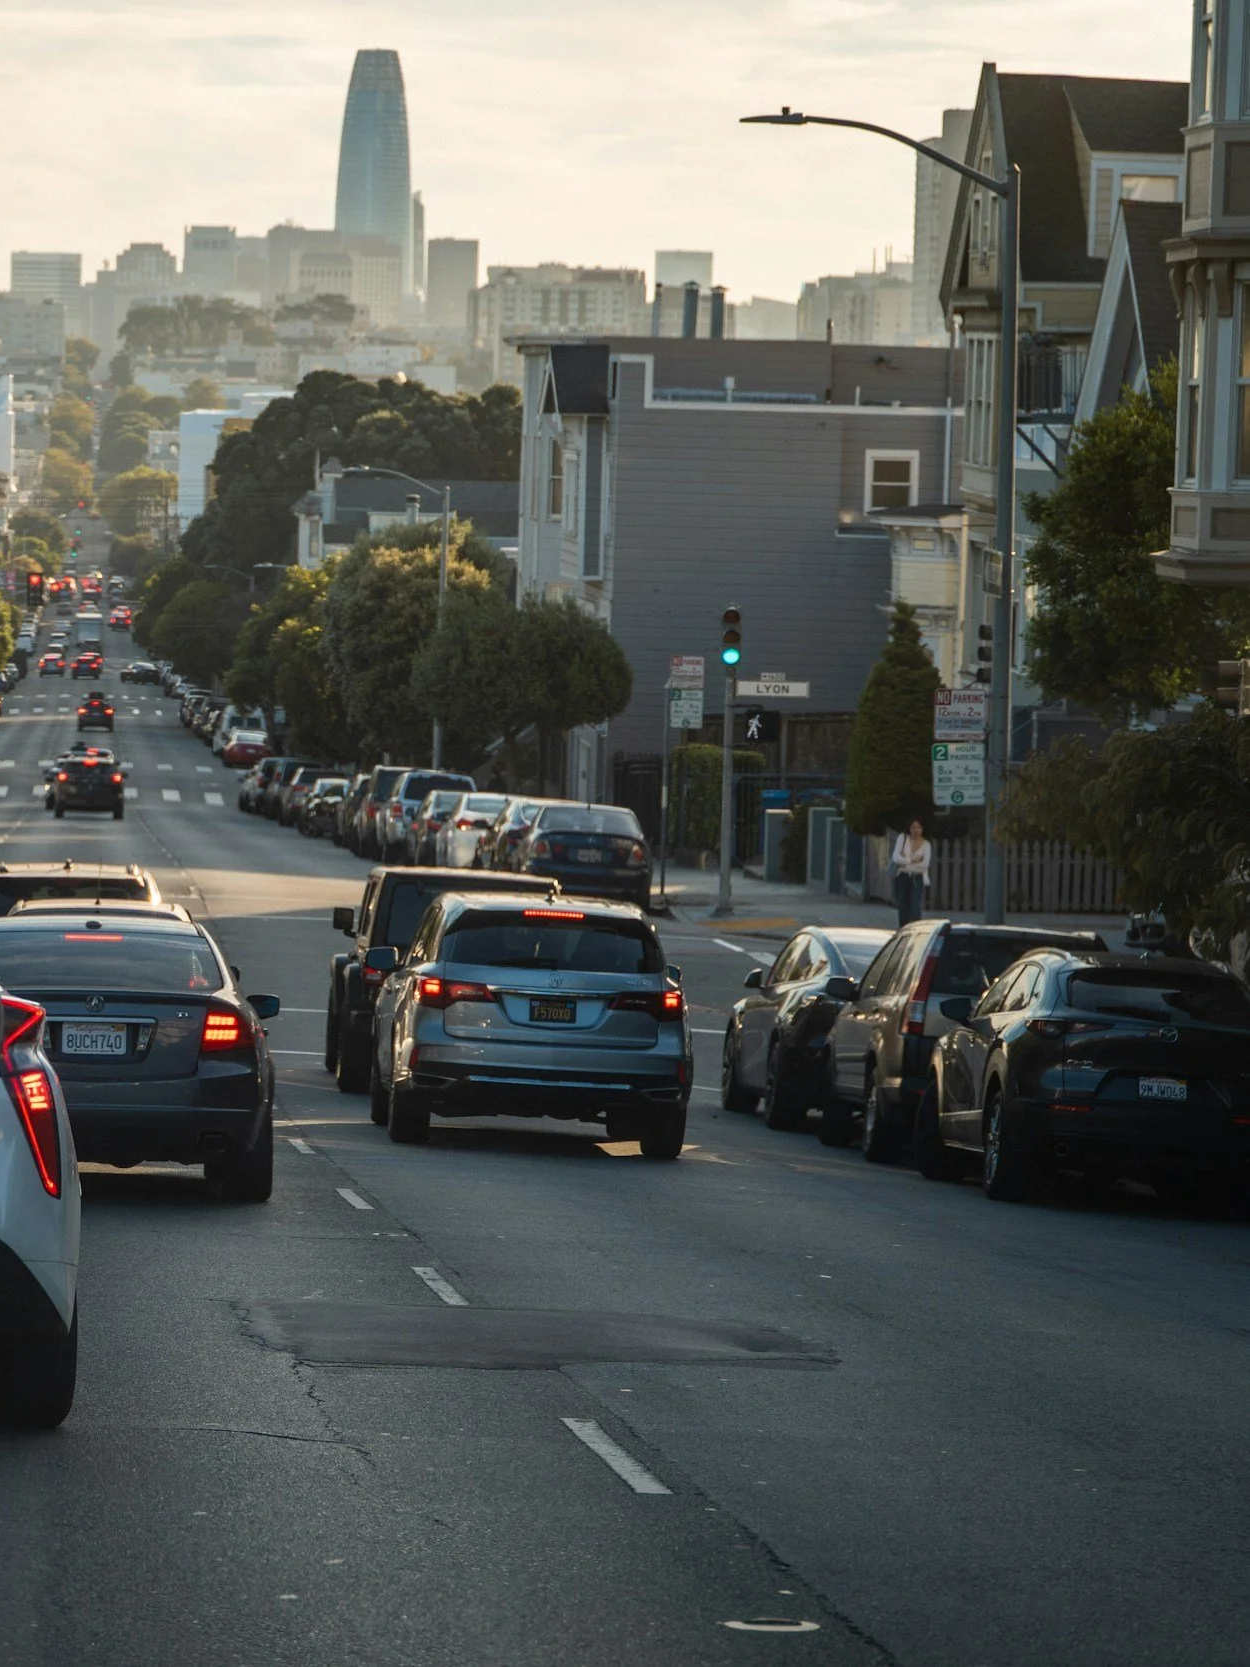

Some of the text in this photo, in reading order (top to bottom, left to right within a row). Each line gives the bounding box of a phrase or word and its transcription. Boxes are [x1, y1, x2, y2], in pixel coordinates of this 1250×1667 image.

[757, 685, 789, 694] LYON
[937, 690, 984, 704] NO PARKING
[936, 746, 946, 759] 2
[66, 1034, 122, 1049] 8UCH740
